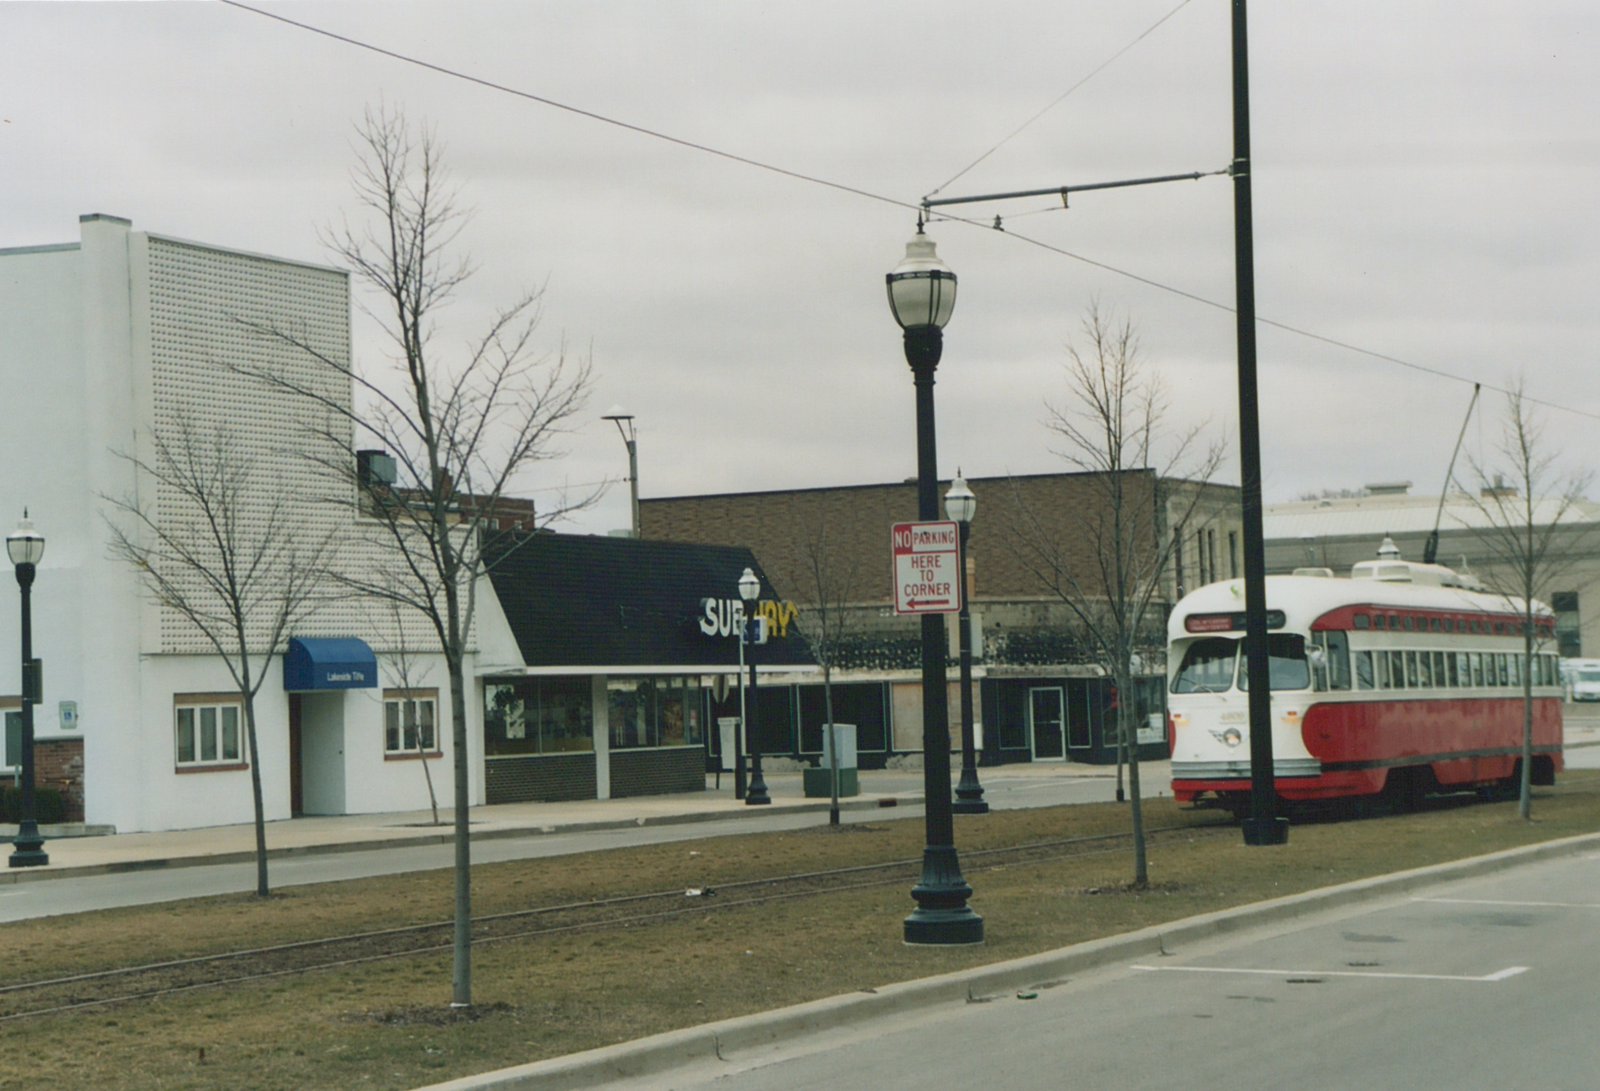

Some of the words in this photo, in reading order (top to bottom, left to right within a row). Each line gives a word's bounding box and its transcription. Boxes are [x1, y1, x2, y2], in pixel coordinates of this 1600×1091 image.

[895, 530, 911, 548] NO
[913, 529, 955, 545] PARKING
[911, 554, 942, 569] HERE
[919, 569, 935, 582] TO
[904, 583, 951, 597] CORNER
[698, 597, 800, 637] SUBAY
